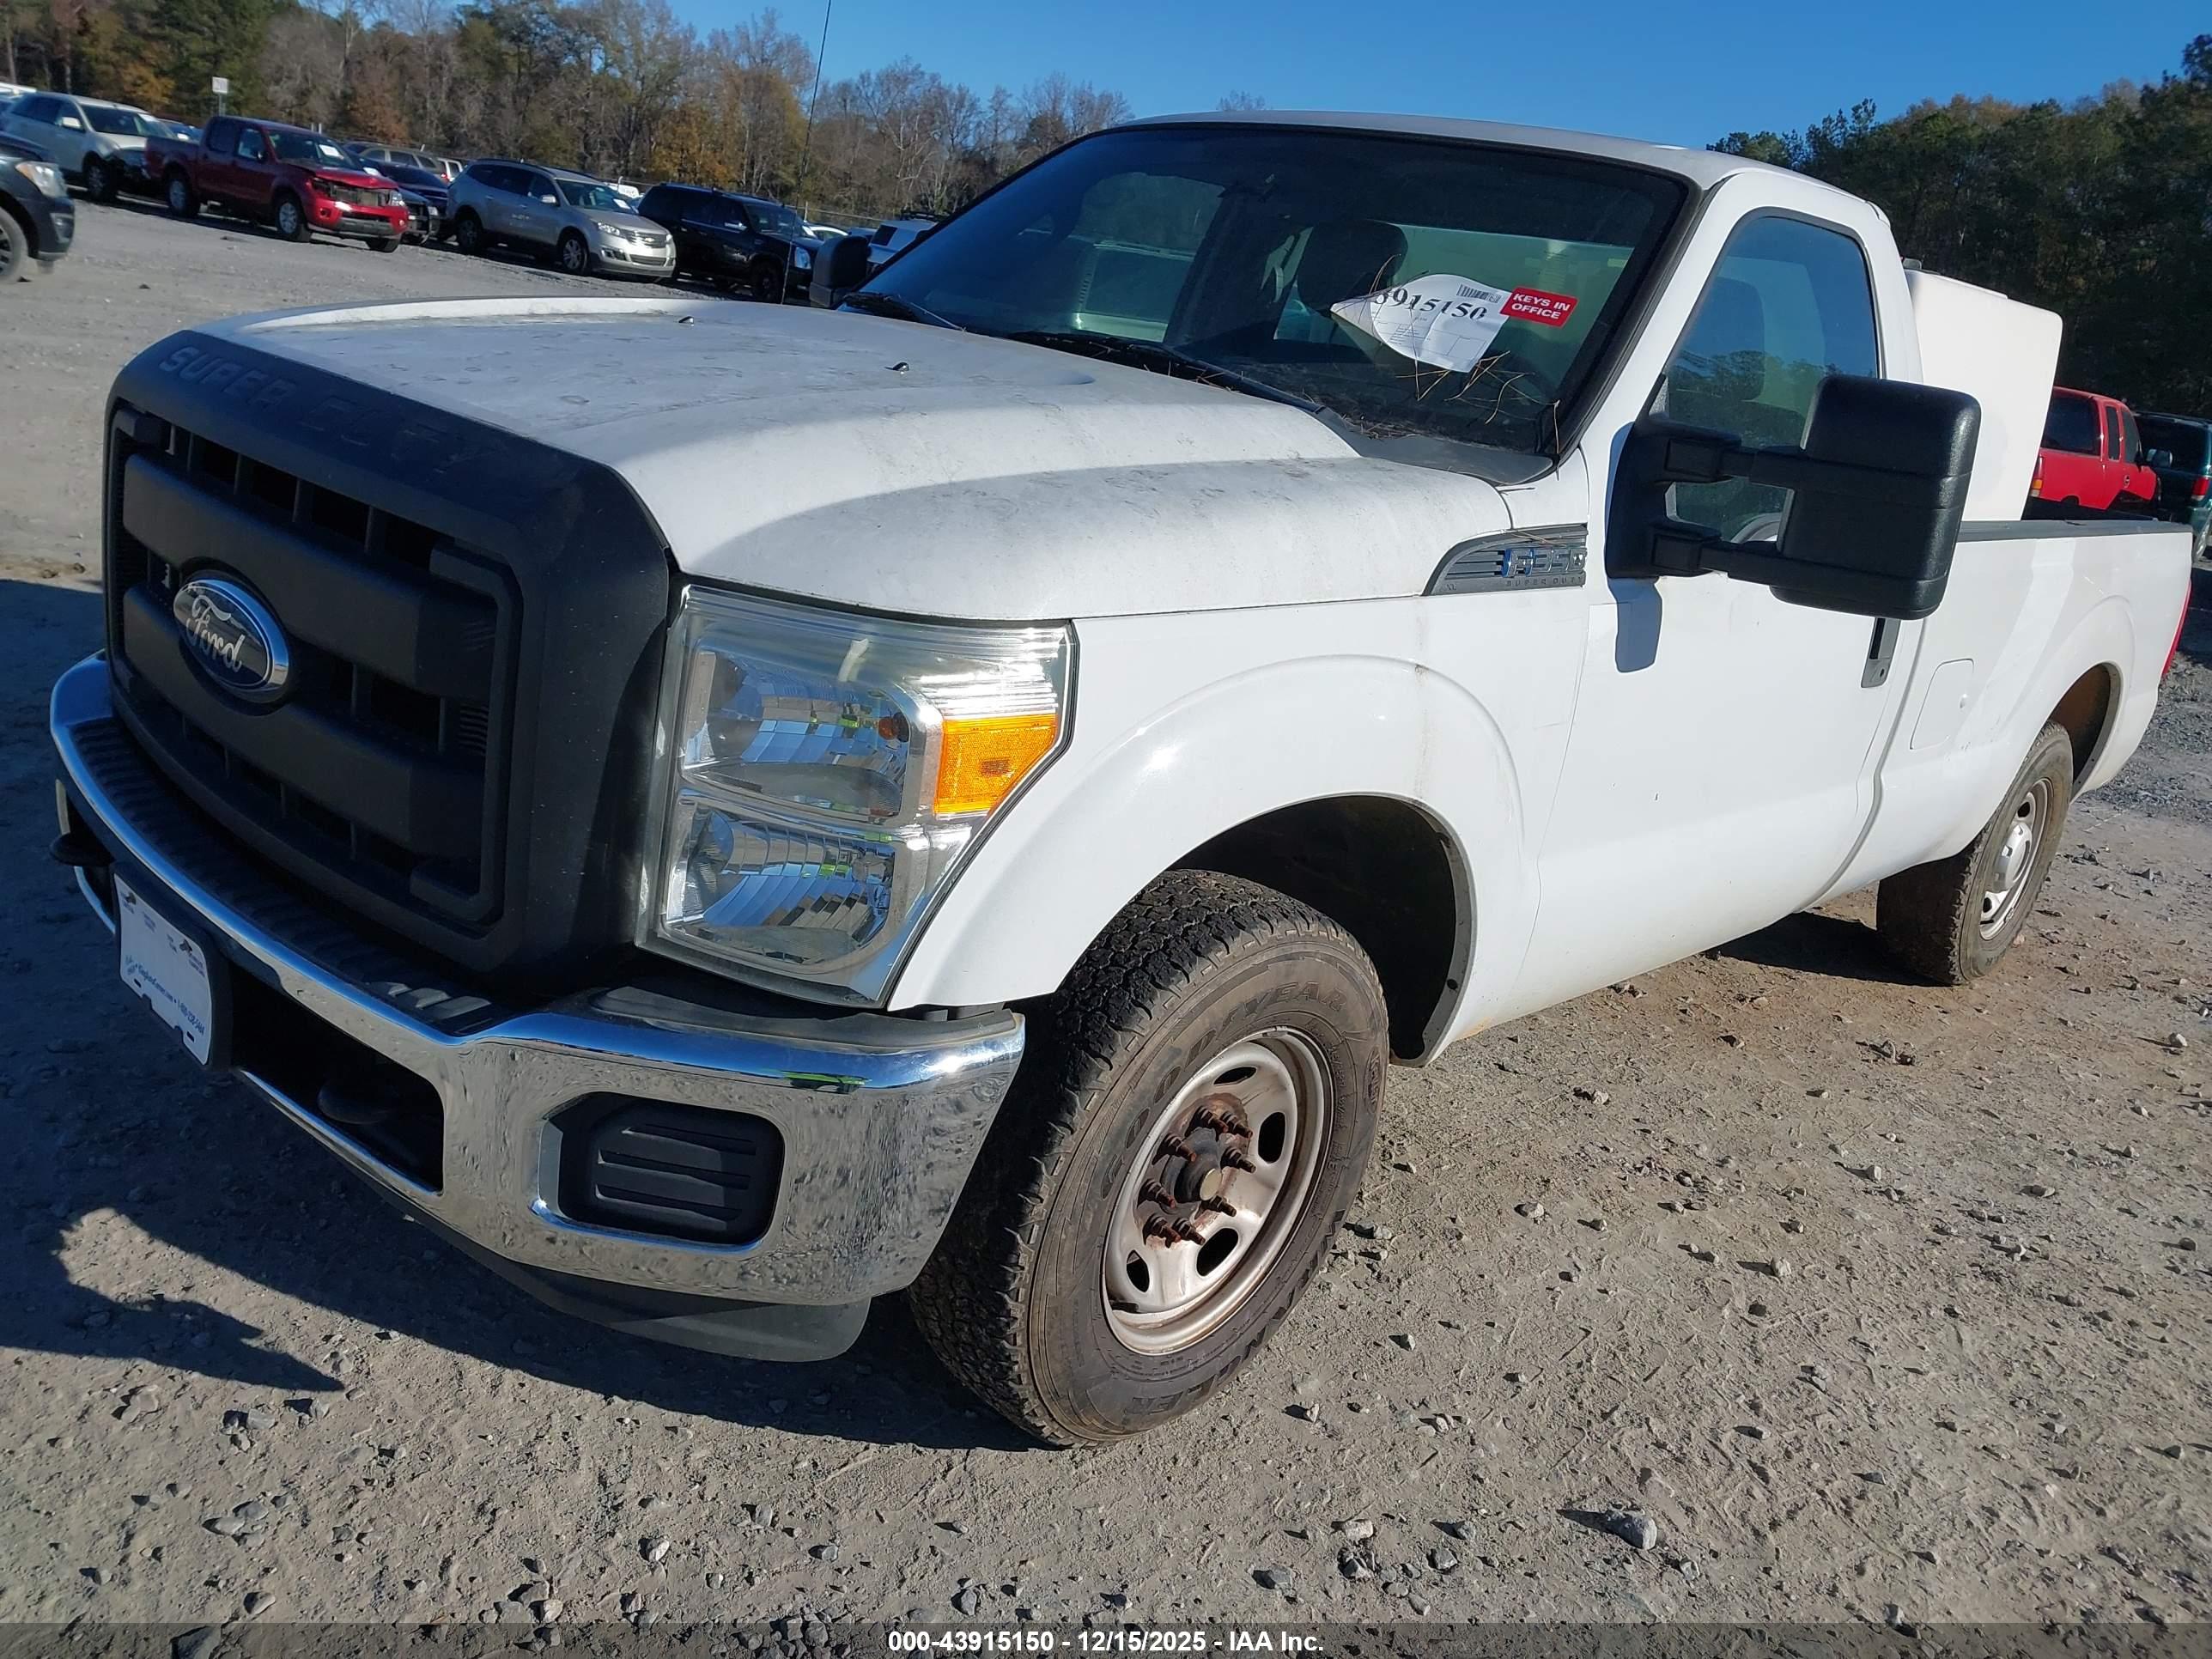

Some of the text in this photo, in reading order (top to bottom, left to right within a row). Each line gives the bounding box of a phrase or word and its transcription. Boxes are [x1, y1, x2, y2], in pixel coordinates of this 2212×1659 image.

[1511, 303, 1561, 319] OFFICE
[1513, 294, 1571, 312] KEYS IN
[158, 345, 297, 410] SUPER
[186, 595, 246, 673] Ford
[1102, 980, 1346, 1200] GOODYEAR
